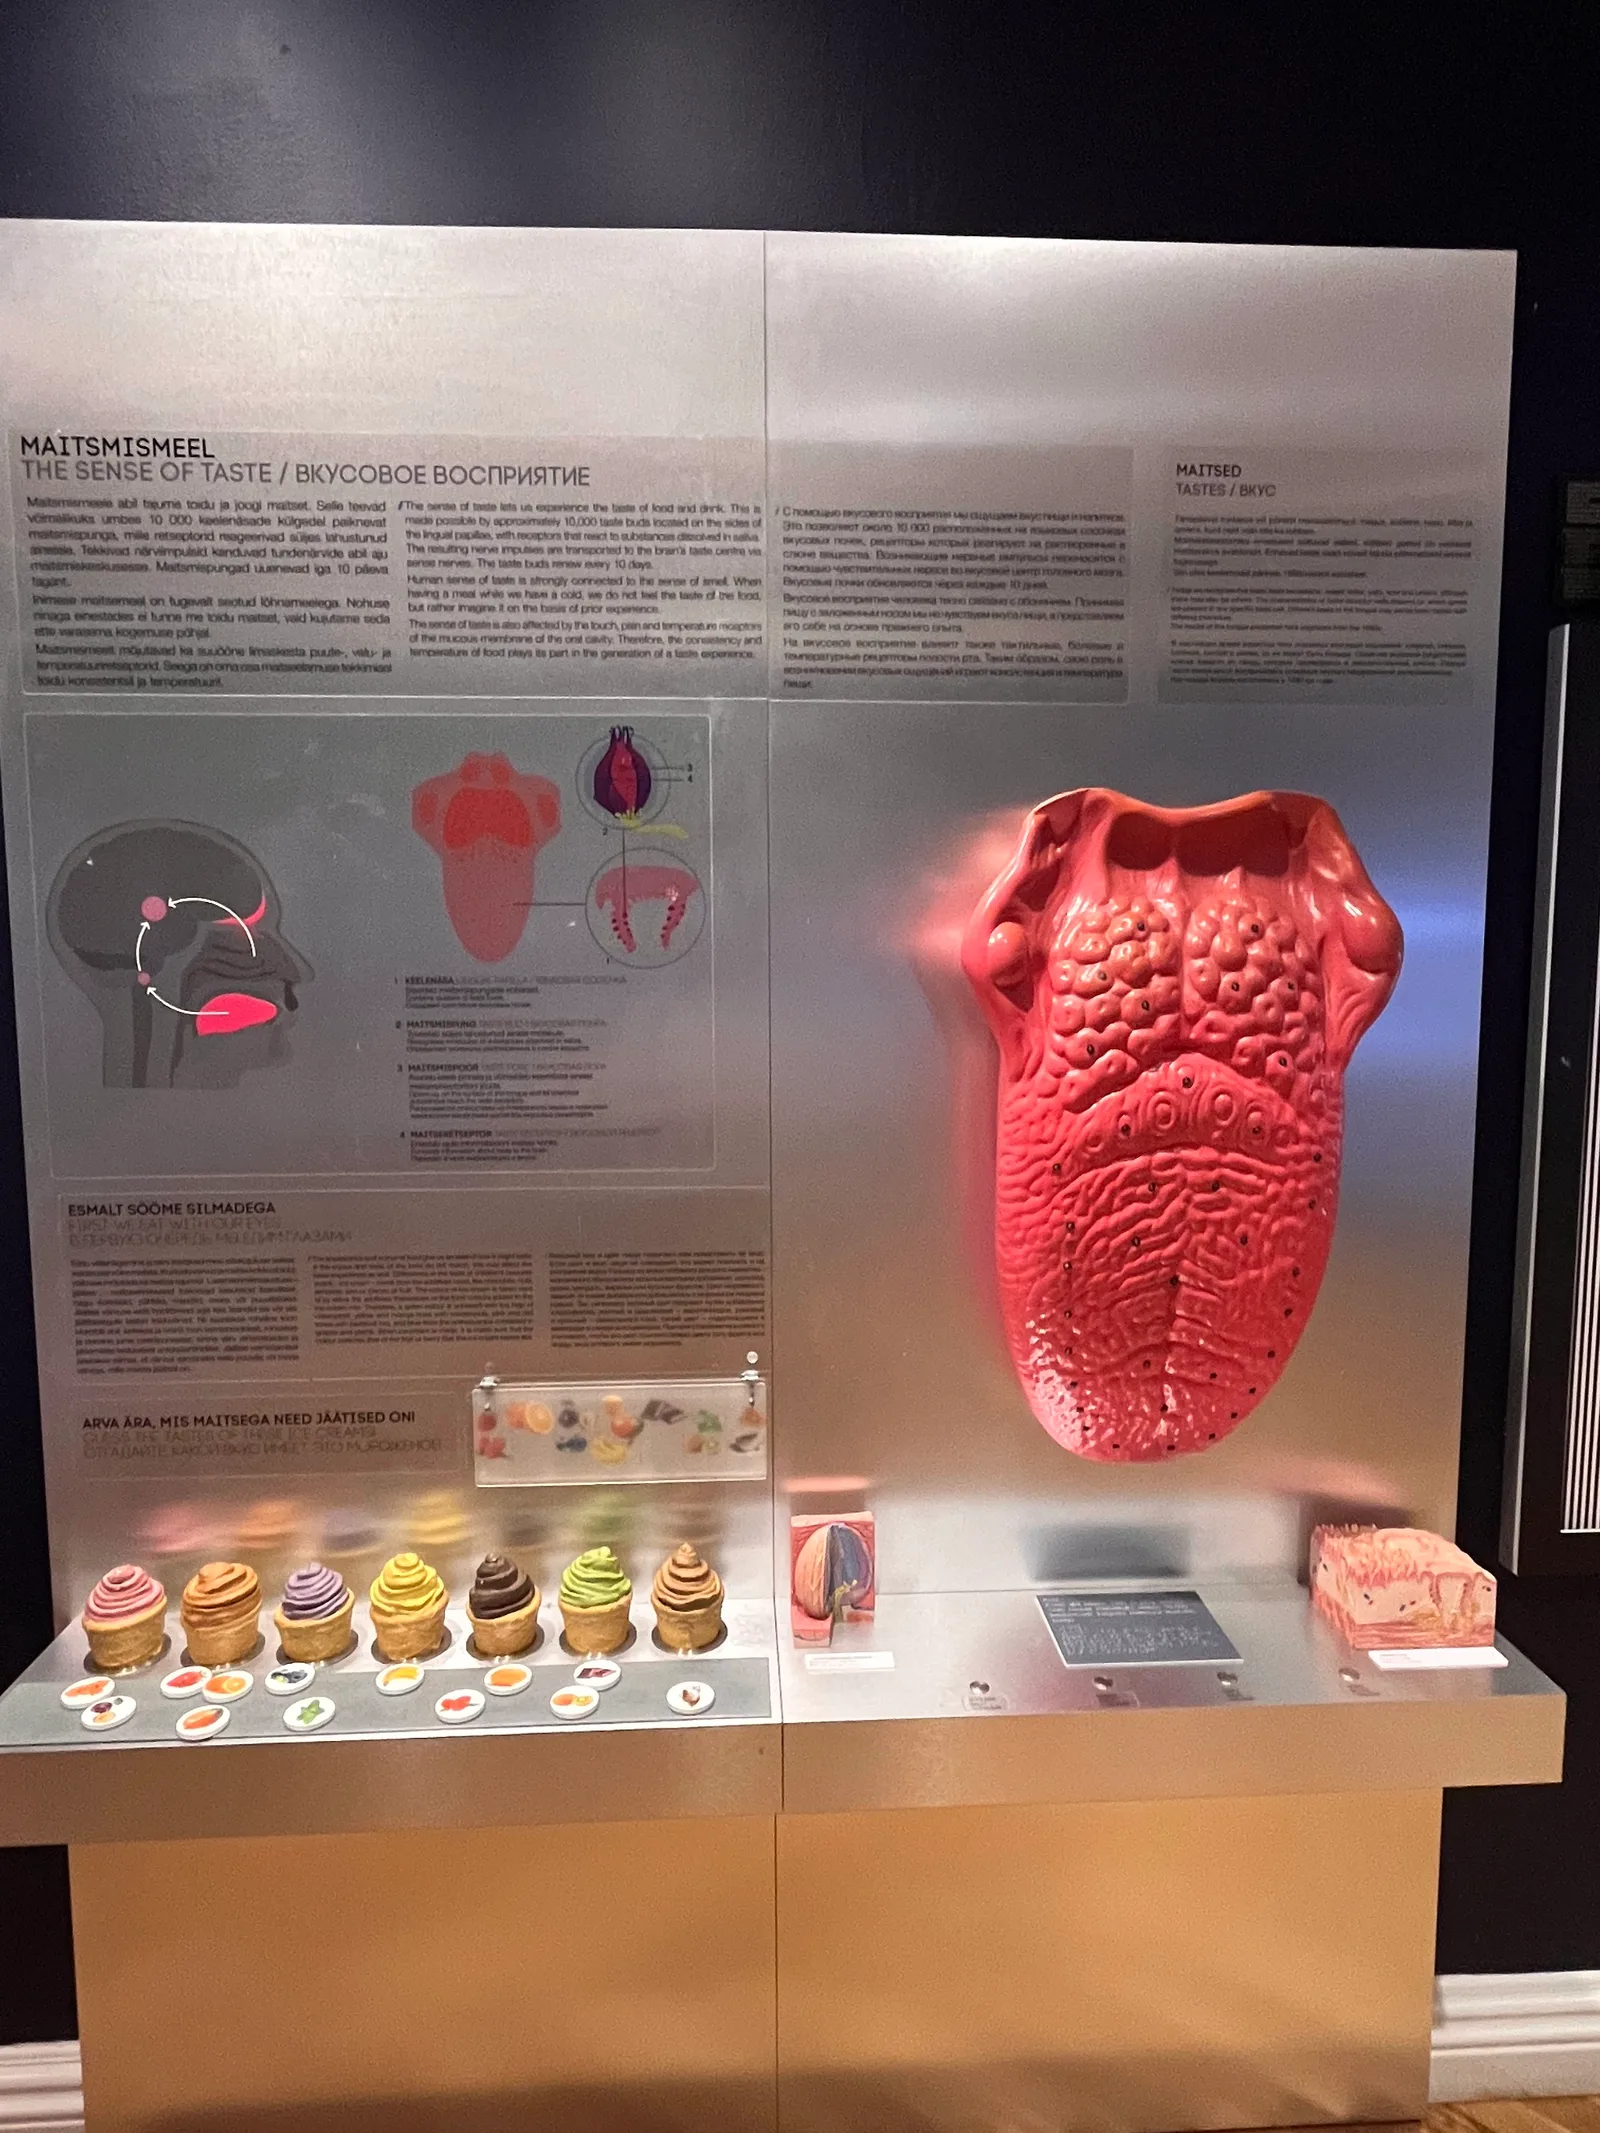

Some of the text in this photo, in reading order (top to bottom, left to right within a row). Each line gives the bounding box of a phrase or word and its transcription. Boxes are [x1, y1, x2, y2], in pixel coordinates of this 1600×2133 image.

[21, 436, 215, 458] MAITSMISMEEL
[22, 460, 591, 486] THE SENSE OF TASTE / ВКУСОВОЕ ВОСПРИЯТИЕ
[1176, 464, 1242, 477] MAITSED
[1175, 482, 1226, 496] TASTES
[1239, 483, 1277, 497] ВКУС
[220, 501, 230, 512] ja
[349, 501, 386, 512] teevad
[406, 501, 424, 511] The
[460, 502, 469, 511] of
[536, 504, 589, 514] experience
[593, 503, 608, 512] the
[639, 503, 648, 513] of
[730, 504, 750, 513] This
[151, 514, 163, 525] 10
[169, 514, 192, 525] 000
[338, 564, 350, 575] 10
[478, 558, 495, 568] The
[615, 559, 626, 569] 10
[479, 576, 488, 585] of
[346, 598, 390, 609] Nohuse
[68, 1200, 276, 1217] ESMALT SÖÖME SILMADEGA
[82, 1417, 119, 1429] ARVA
[124, 1414, 156, 1429] ÄRA,
[160, 1415, 189, 1428] MIS
[194, 1413, 271, 1427] MAITSEGA
[275, 1413, 312, 1426] NEED
[316, 1410, 386, 1425] JÄÄTISED
